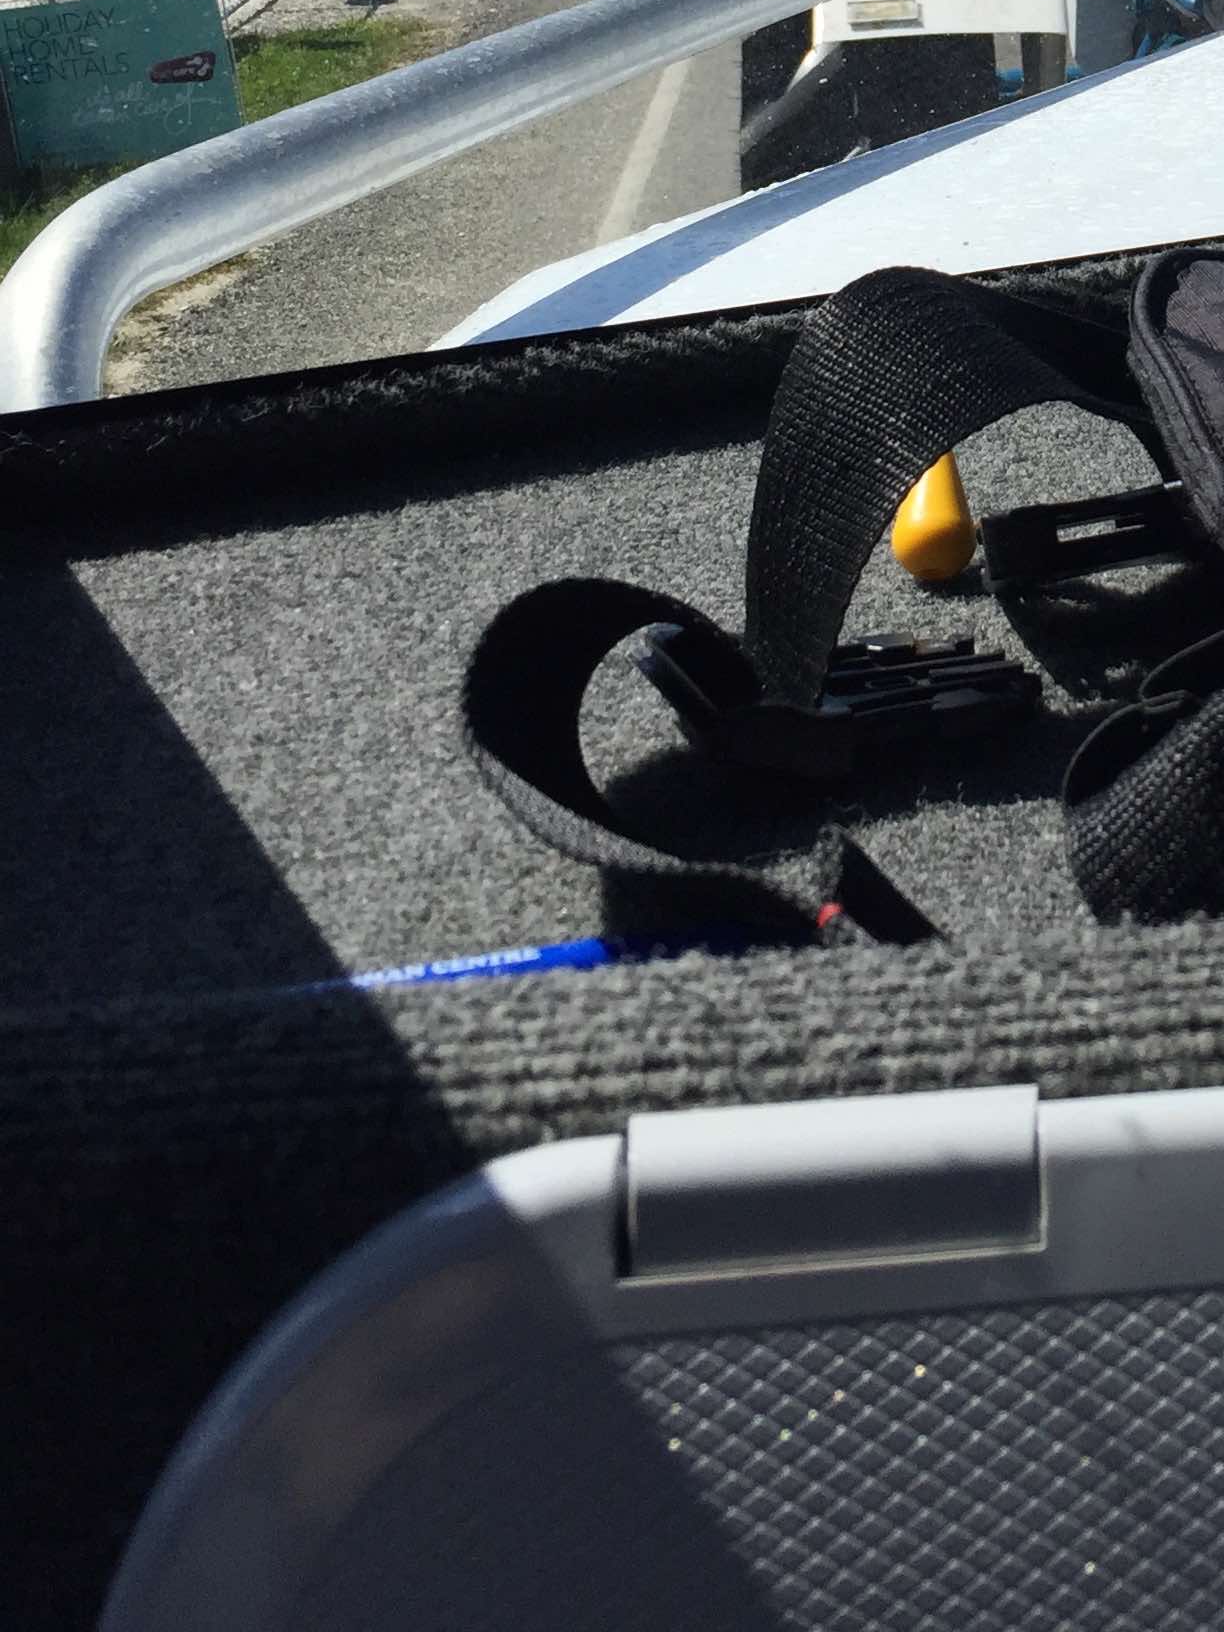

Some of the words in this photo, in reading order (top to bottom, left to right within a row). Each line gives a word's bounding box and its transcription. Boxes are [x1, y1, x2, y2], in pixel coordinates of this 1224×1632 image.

[3, 7, 116, 40] HOLIDAY
[8, 36, 98, 62] HOME
[14, 51, 130, 85] RENTALS
